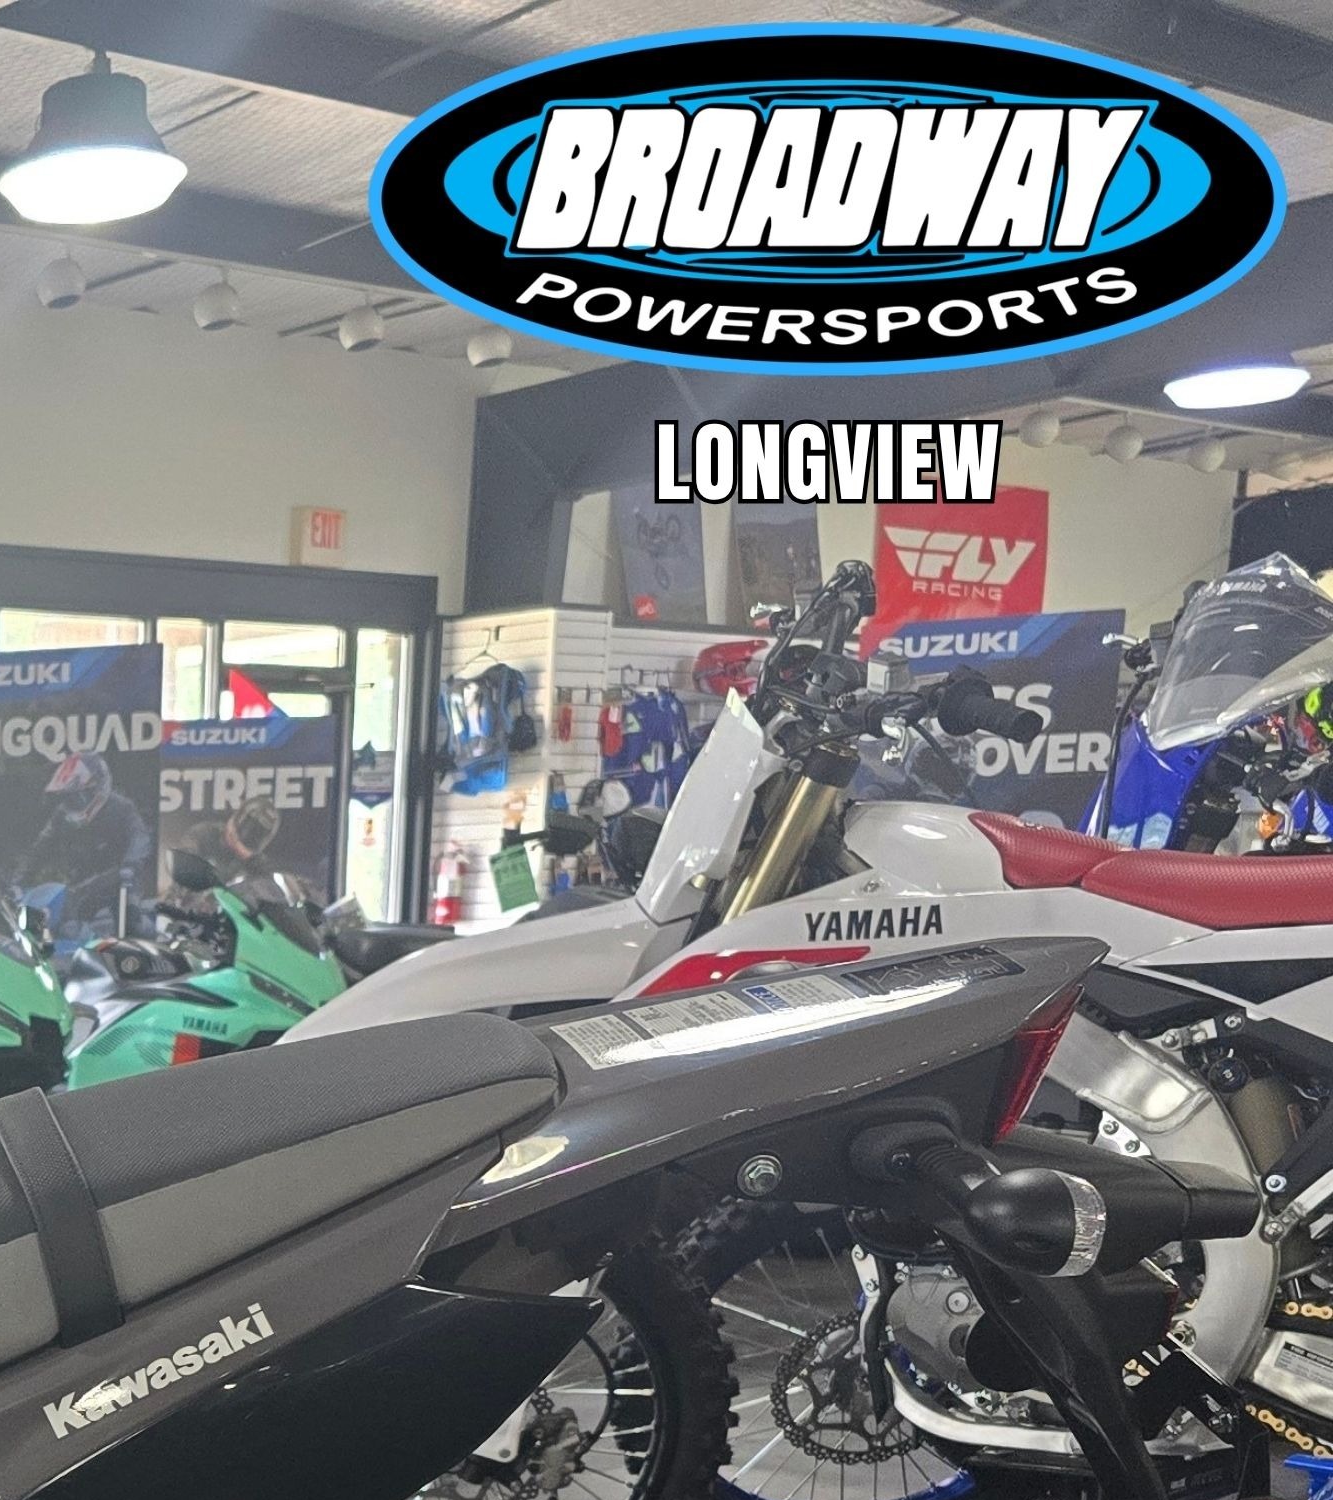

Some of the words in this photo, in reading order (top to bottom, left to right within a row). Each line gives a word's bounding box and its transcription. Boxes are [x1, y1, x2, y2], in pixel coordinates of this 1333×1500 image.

[311, 510, 342, 550] EXIT
[884, 525, 1036, 584] FLY
[912, 582, 1005, 600] RACING
[878, 630, 1018, 658] SUZUKI
[171, 727, 267, 747] SUZUKI
[975, 732, 1112, 778] OVER
[159, 765, 333, 813] STREET
[805, 904, 943, 942] YAMAHA
[182, 1015, 228, 1037] YAMAHA
[42, 1303, 275, 1439] Kawasaki
